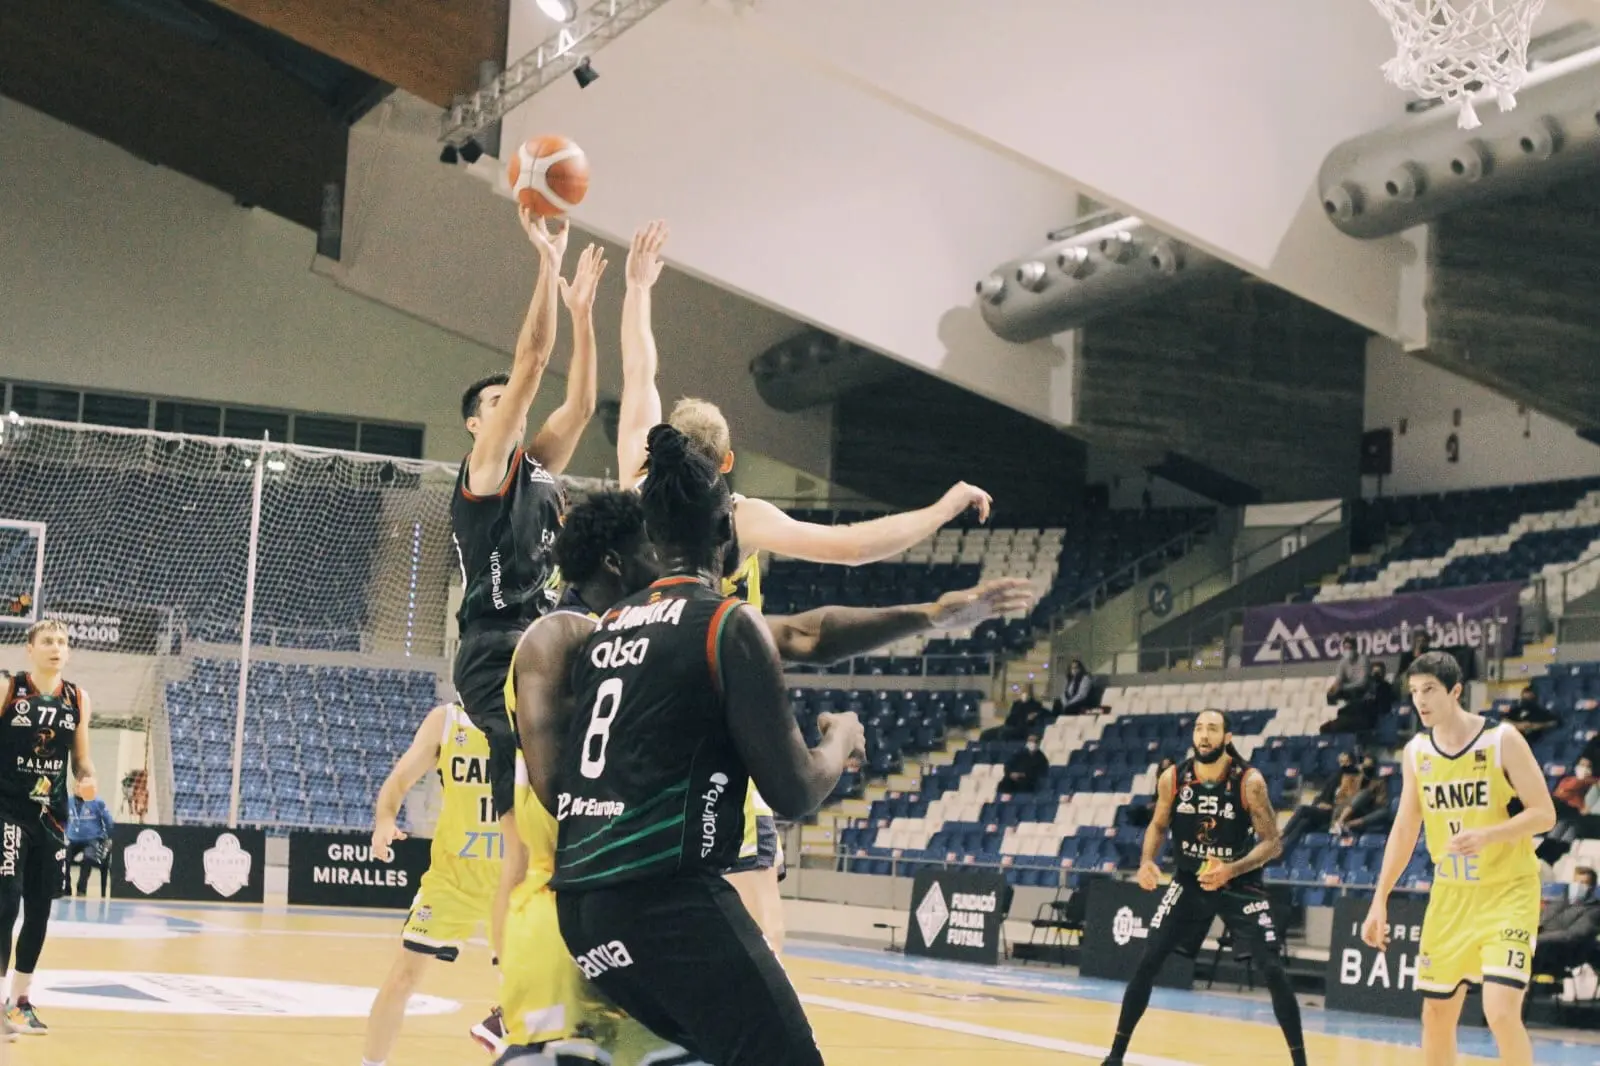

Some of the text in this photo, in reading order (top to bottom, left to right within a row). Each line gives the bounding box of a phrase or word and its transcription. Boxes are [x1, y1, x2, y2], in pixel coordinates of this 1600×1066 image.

[37, 706, 57, 726] 77
[580, 677, 624, 780] 8
[1198, 796, 1218, 815] 25
[1182, 840, 1233, 857] PALMER
[313, 866, 408, 887] MIRALLES
[1507, 950, 1525, 969] 13
